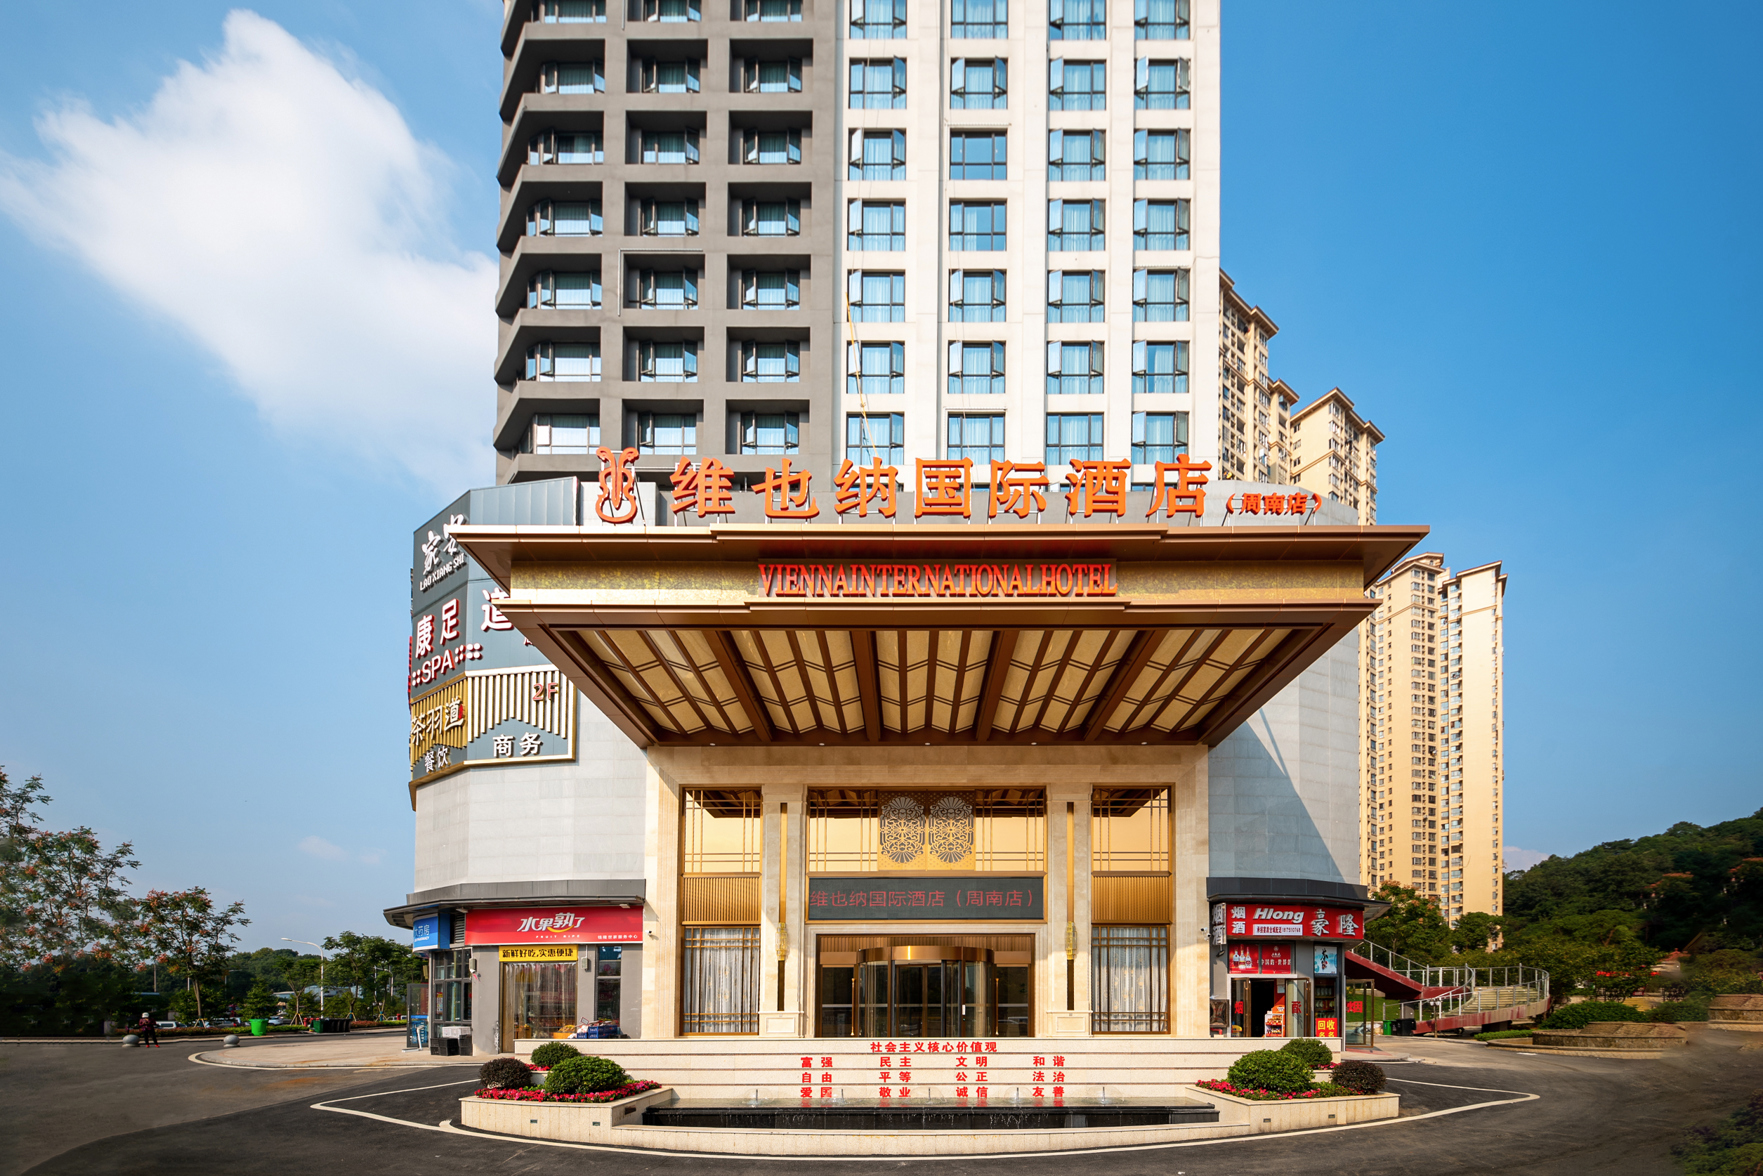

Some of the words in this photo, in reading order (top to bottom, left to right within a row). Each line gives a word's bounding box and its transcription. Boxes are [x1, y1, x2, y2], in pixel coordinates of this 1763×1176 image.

[669, 453, 1213, 519] 维也纳国际酒店
[420, 575, 432, 591] LAO
[432, 561, 453, 582] XIANG
[421, 650, 455, 683] SPA
[532, 682, 558, 700] 2F
[411, 696, 463, 746] 茶羽道
[492, 732, 542, 757] 商务
[424, 746, 449, 773] 餐饮
[517, 912, 585, 932] 水果熟了
[1253, 908, 1304, 923] Hlong
[1318, 1020, 1335, 1031] 回收
[870, 1041, 998, 1053] 社会主义核心价值观
[800, 1056, 833, 1068] 富强
[879, 1056, 912, 1068] 民主
[955, 1056, 988, 1068] 文明
[1032, 1056, 1065, 1068] 和谐
[800, 1071, 833, 1083] 自由
[879, 1071, 912, 1083] 平等
[955, 1071, 988, 1083] 公正
[1032, 1071, 1065, 1083] 法治
[879, 1086, 912, 1099] 敬业
[955, 1086, 988, 1099] 诚信
[1032, 1086, 1065, 1099] 友善
